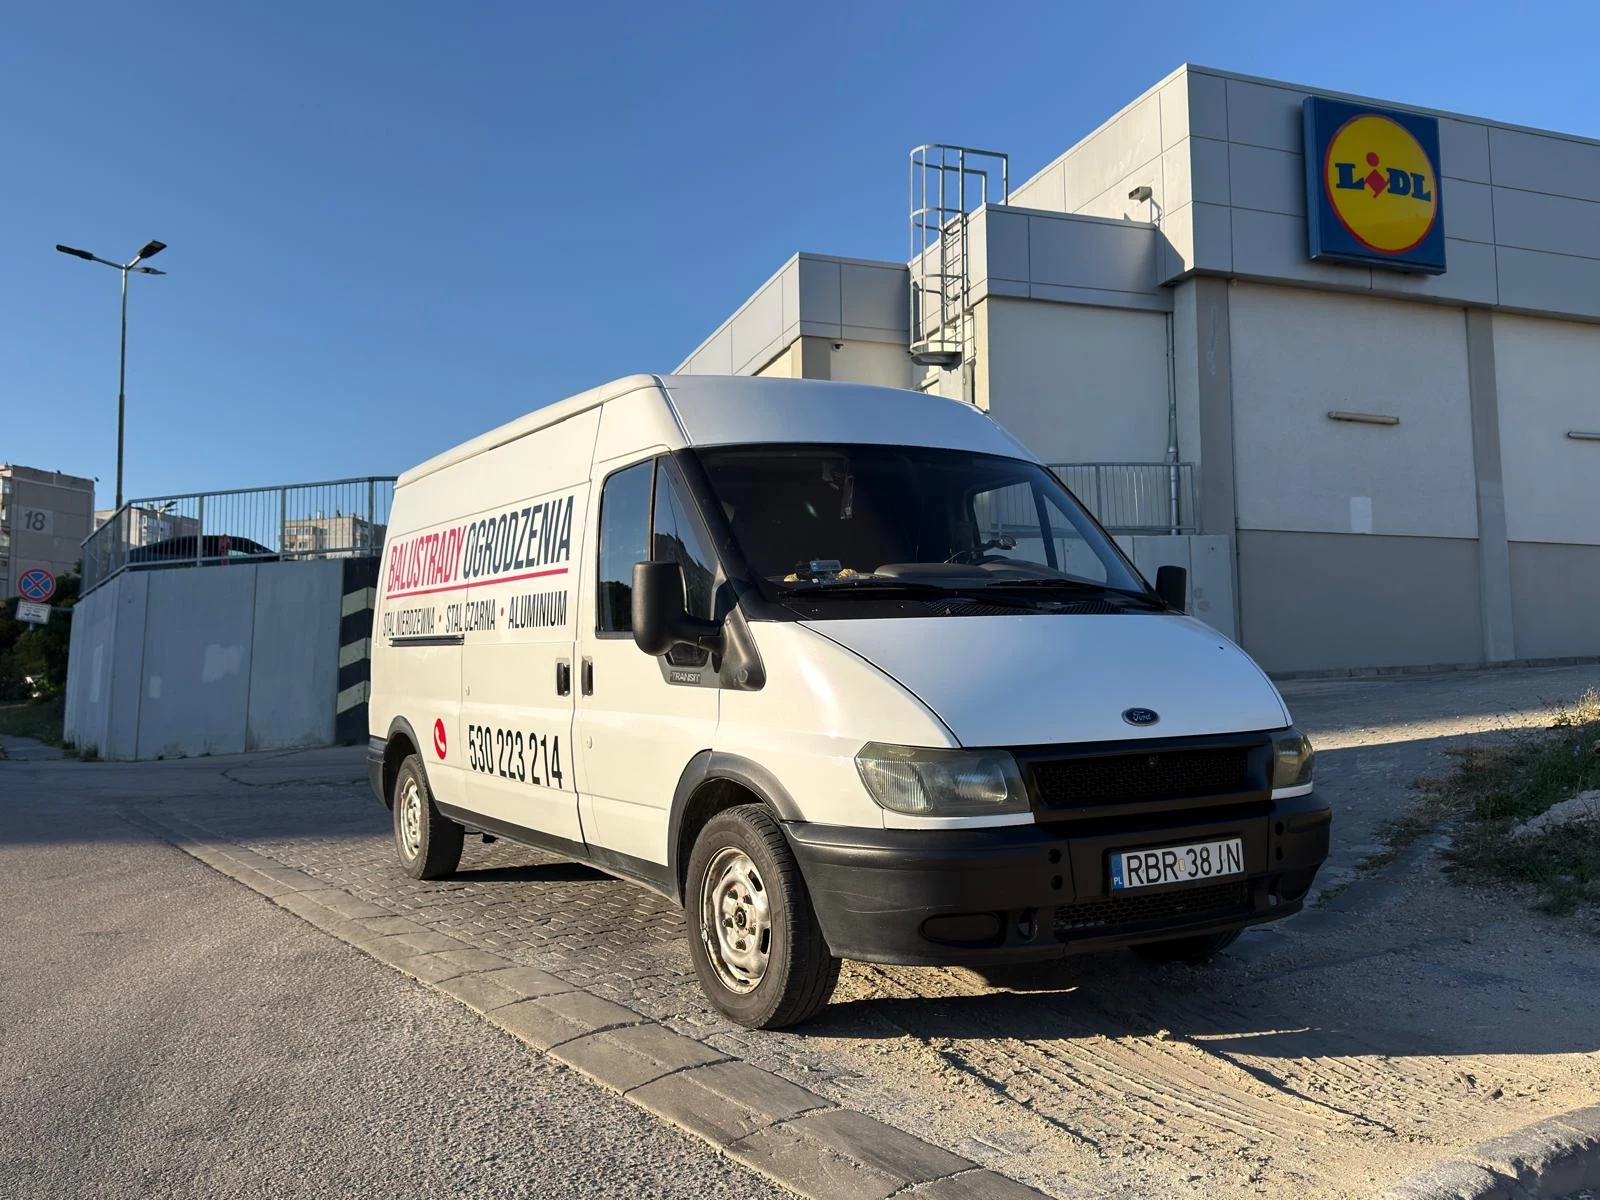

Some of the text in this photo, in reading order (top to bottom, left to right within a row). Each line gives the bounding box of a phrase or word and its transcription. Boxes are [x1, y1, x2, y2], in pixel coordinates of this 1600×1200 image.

[24, 510, 46, 531] 18
[387, 495, 574, 592] BALUSTRADY OGRODZENIA
[383, 611, 395, 637] STAL
[445, 602, 463, 633] STAL
[464, 598, 496, 632] CZARNA
[507, 590, 568, 630] ALUMINIUM
[671, 671, 701, 683] TRANSIT
[468, 724, 563, 790] 530 223 214
[1113, 876, 1123, 886] PL
[1126, 850, 1180, 886] RBR
